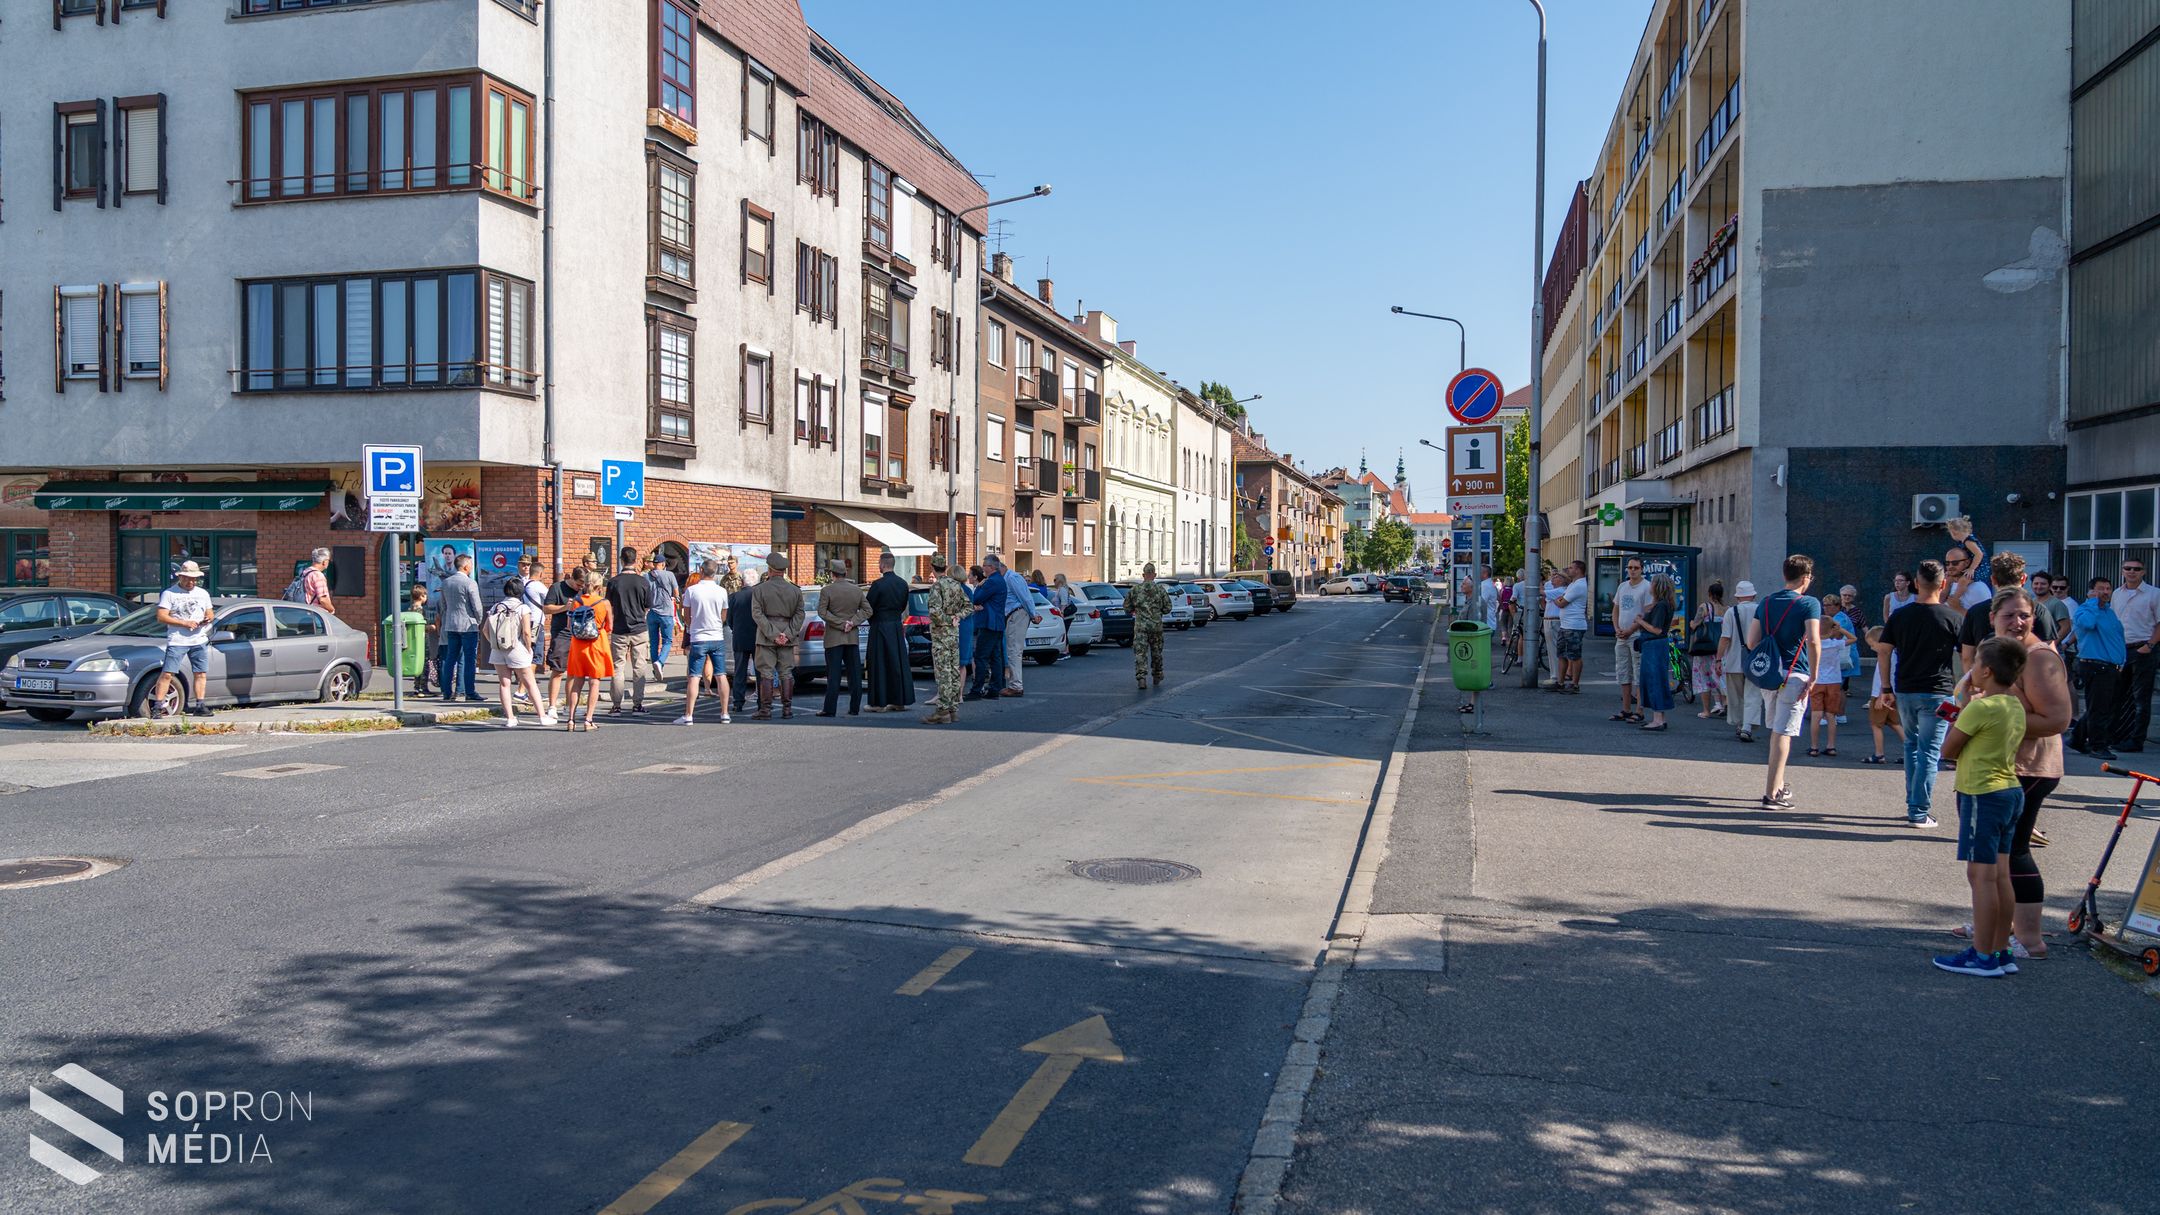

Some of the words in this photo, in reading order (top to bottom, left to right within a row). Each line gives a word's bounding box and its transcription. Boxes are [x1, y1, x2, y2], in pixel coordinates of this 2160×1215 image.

[380, 457, 406, 486] P
[607, 465, 621, 486] P
[1465, 480, 1483, 490] 900
[1485, 481, 1495, 489] m
[1464, 502, 1499, 510] tourinform
[22, 679, 53, 689] MOG-153
